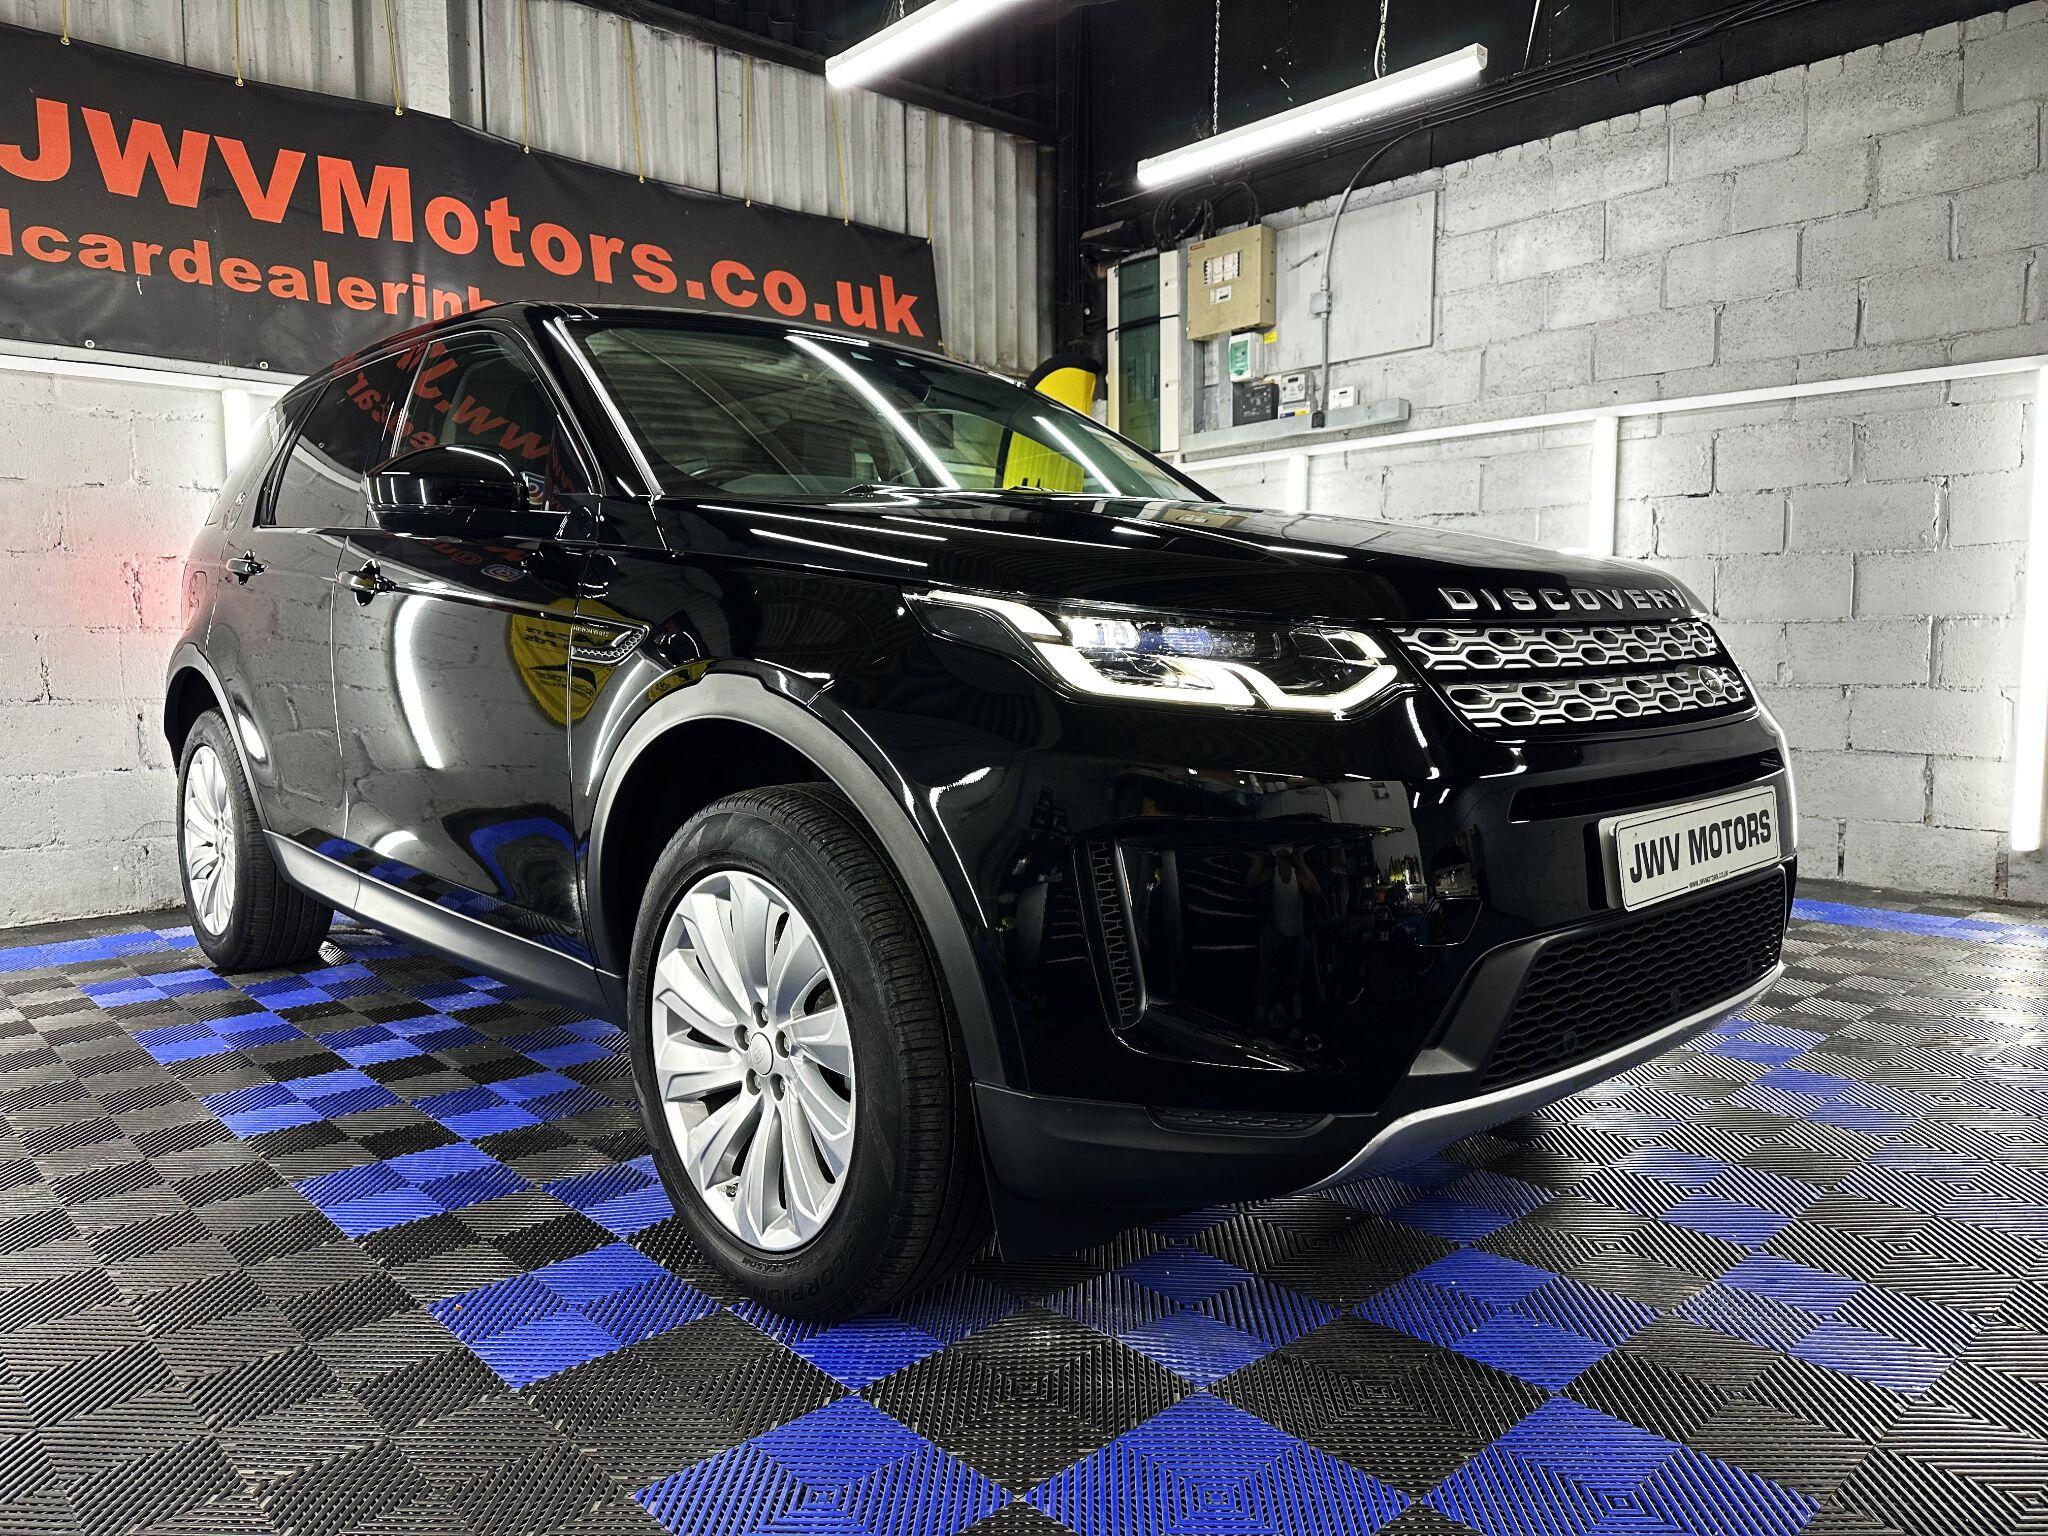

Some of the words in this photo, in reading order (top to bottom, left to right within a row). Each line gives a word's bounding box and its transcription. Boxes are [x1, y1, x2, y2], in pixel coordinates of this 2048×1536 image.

[0, 98, 924, 337] JWVMotors.co.uk
[1437, 587, 1686, 611] DISCOVERY
[1629, 833, 1680, 884] JWV
[1687, 809, 1772, 866] MOTORS
